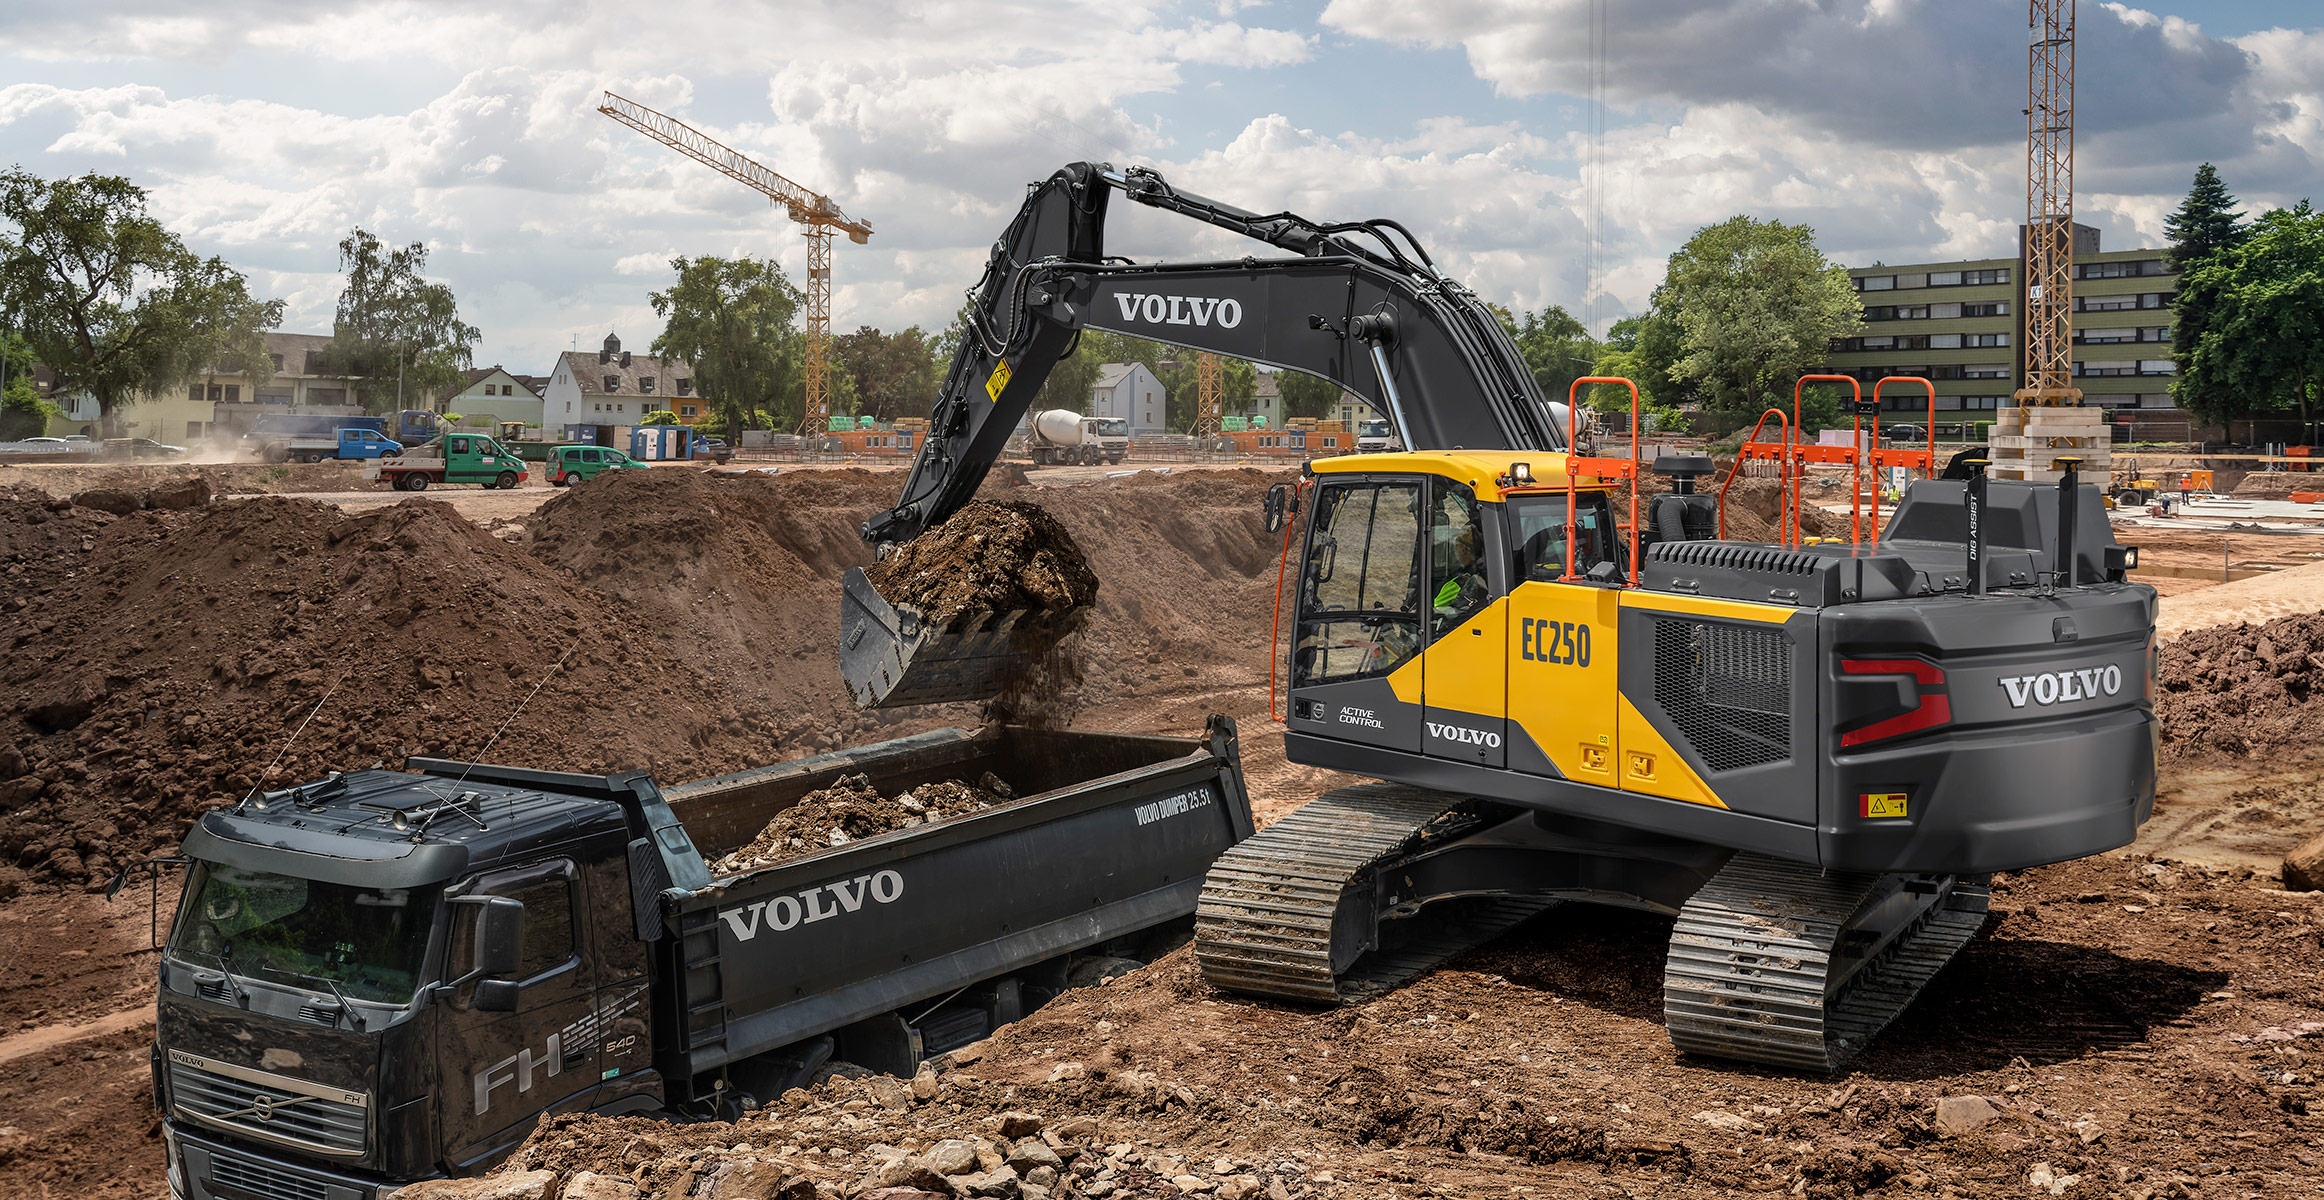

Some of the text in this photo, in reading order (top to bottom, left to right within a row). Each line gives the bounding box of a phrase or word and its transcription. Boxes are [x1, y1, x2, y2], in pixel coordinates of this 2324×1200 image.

[1113, 292, 1242, 329] VOLVO
[1969, 493, 1978, 561] DIG ASSIST
[1522, 617, 1591, 668] EC250
[1999, 664, 2122, 707] VOLVO
[1339, 714, 1385, 730] CONTROL
[1340, 706, 1375, 719] ACTIVE
[1426, 721, 1501, 748] VOLVO
[1134, 788, 1211, 826] VOLVO DUMPER 25.5t
[719, 869, 904, 942] VOLVO
[171, 1052, 204, 1068] VOLVO
[474, 1032, 561, 1116] FH
[344, 1094, 361, 1104] FH
